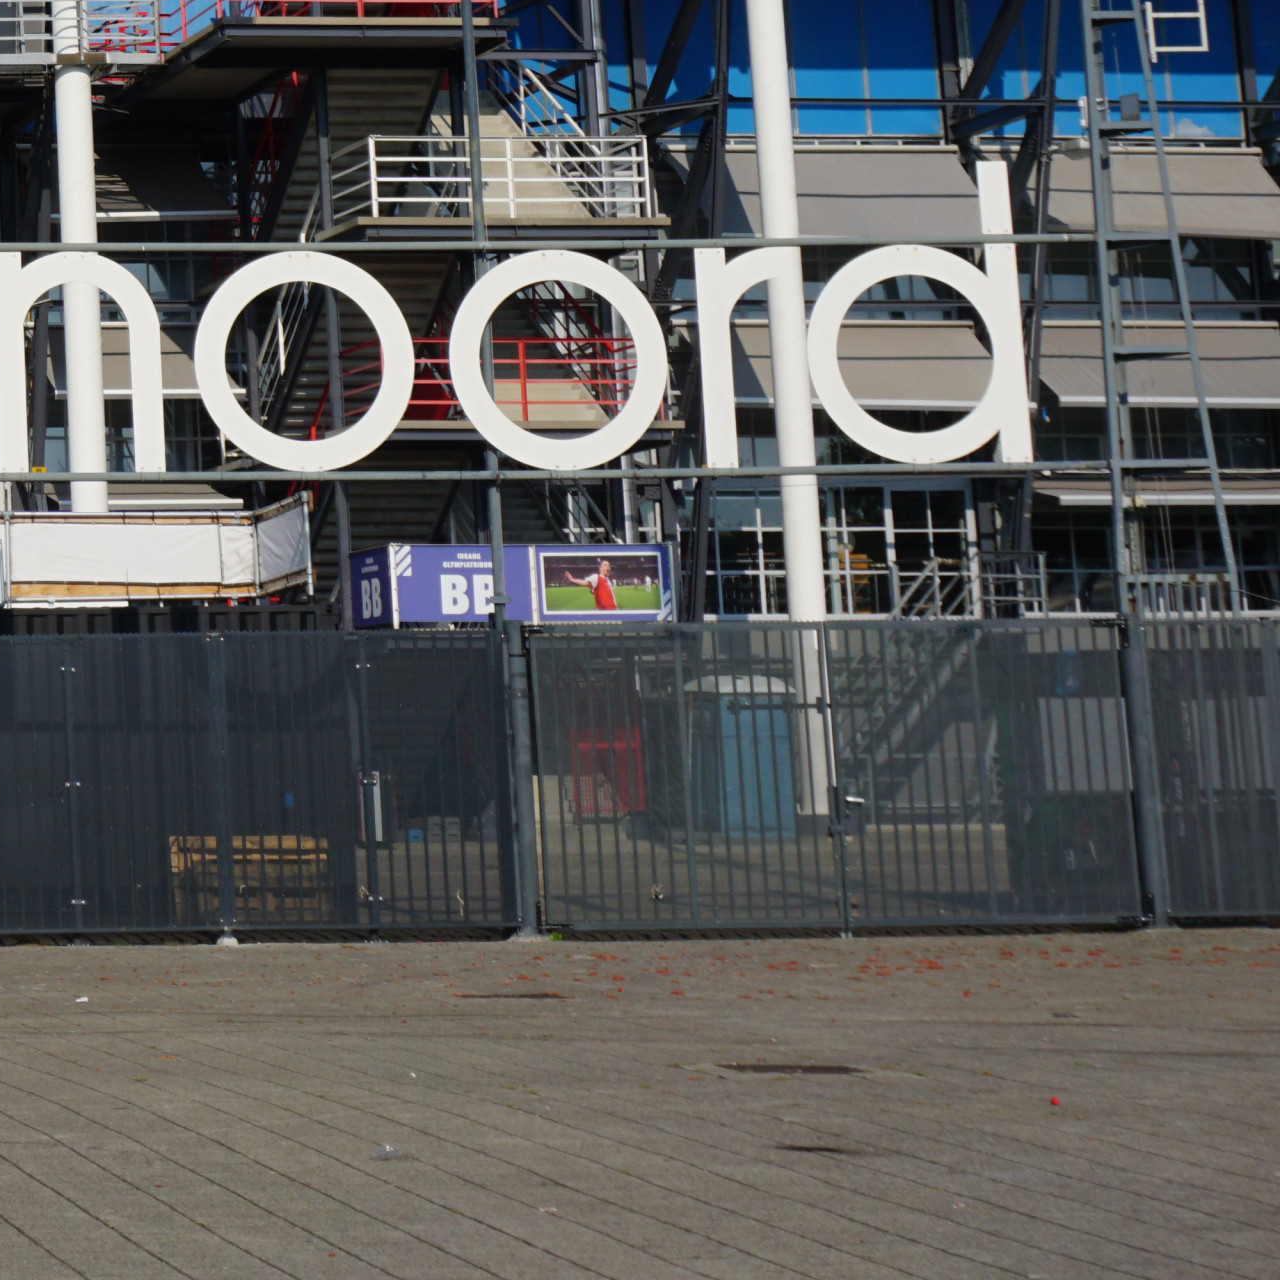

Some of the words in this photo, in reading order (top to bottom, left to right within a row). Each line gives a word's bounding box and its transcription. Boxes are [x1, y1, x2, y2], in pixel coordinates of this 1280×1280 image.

[443, 561, 493, 569] OLYMPIATRIBUN
[360, 577, 382, 619] BB
[440, 574, 495, 615] BB
